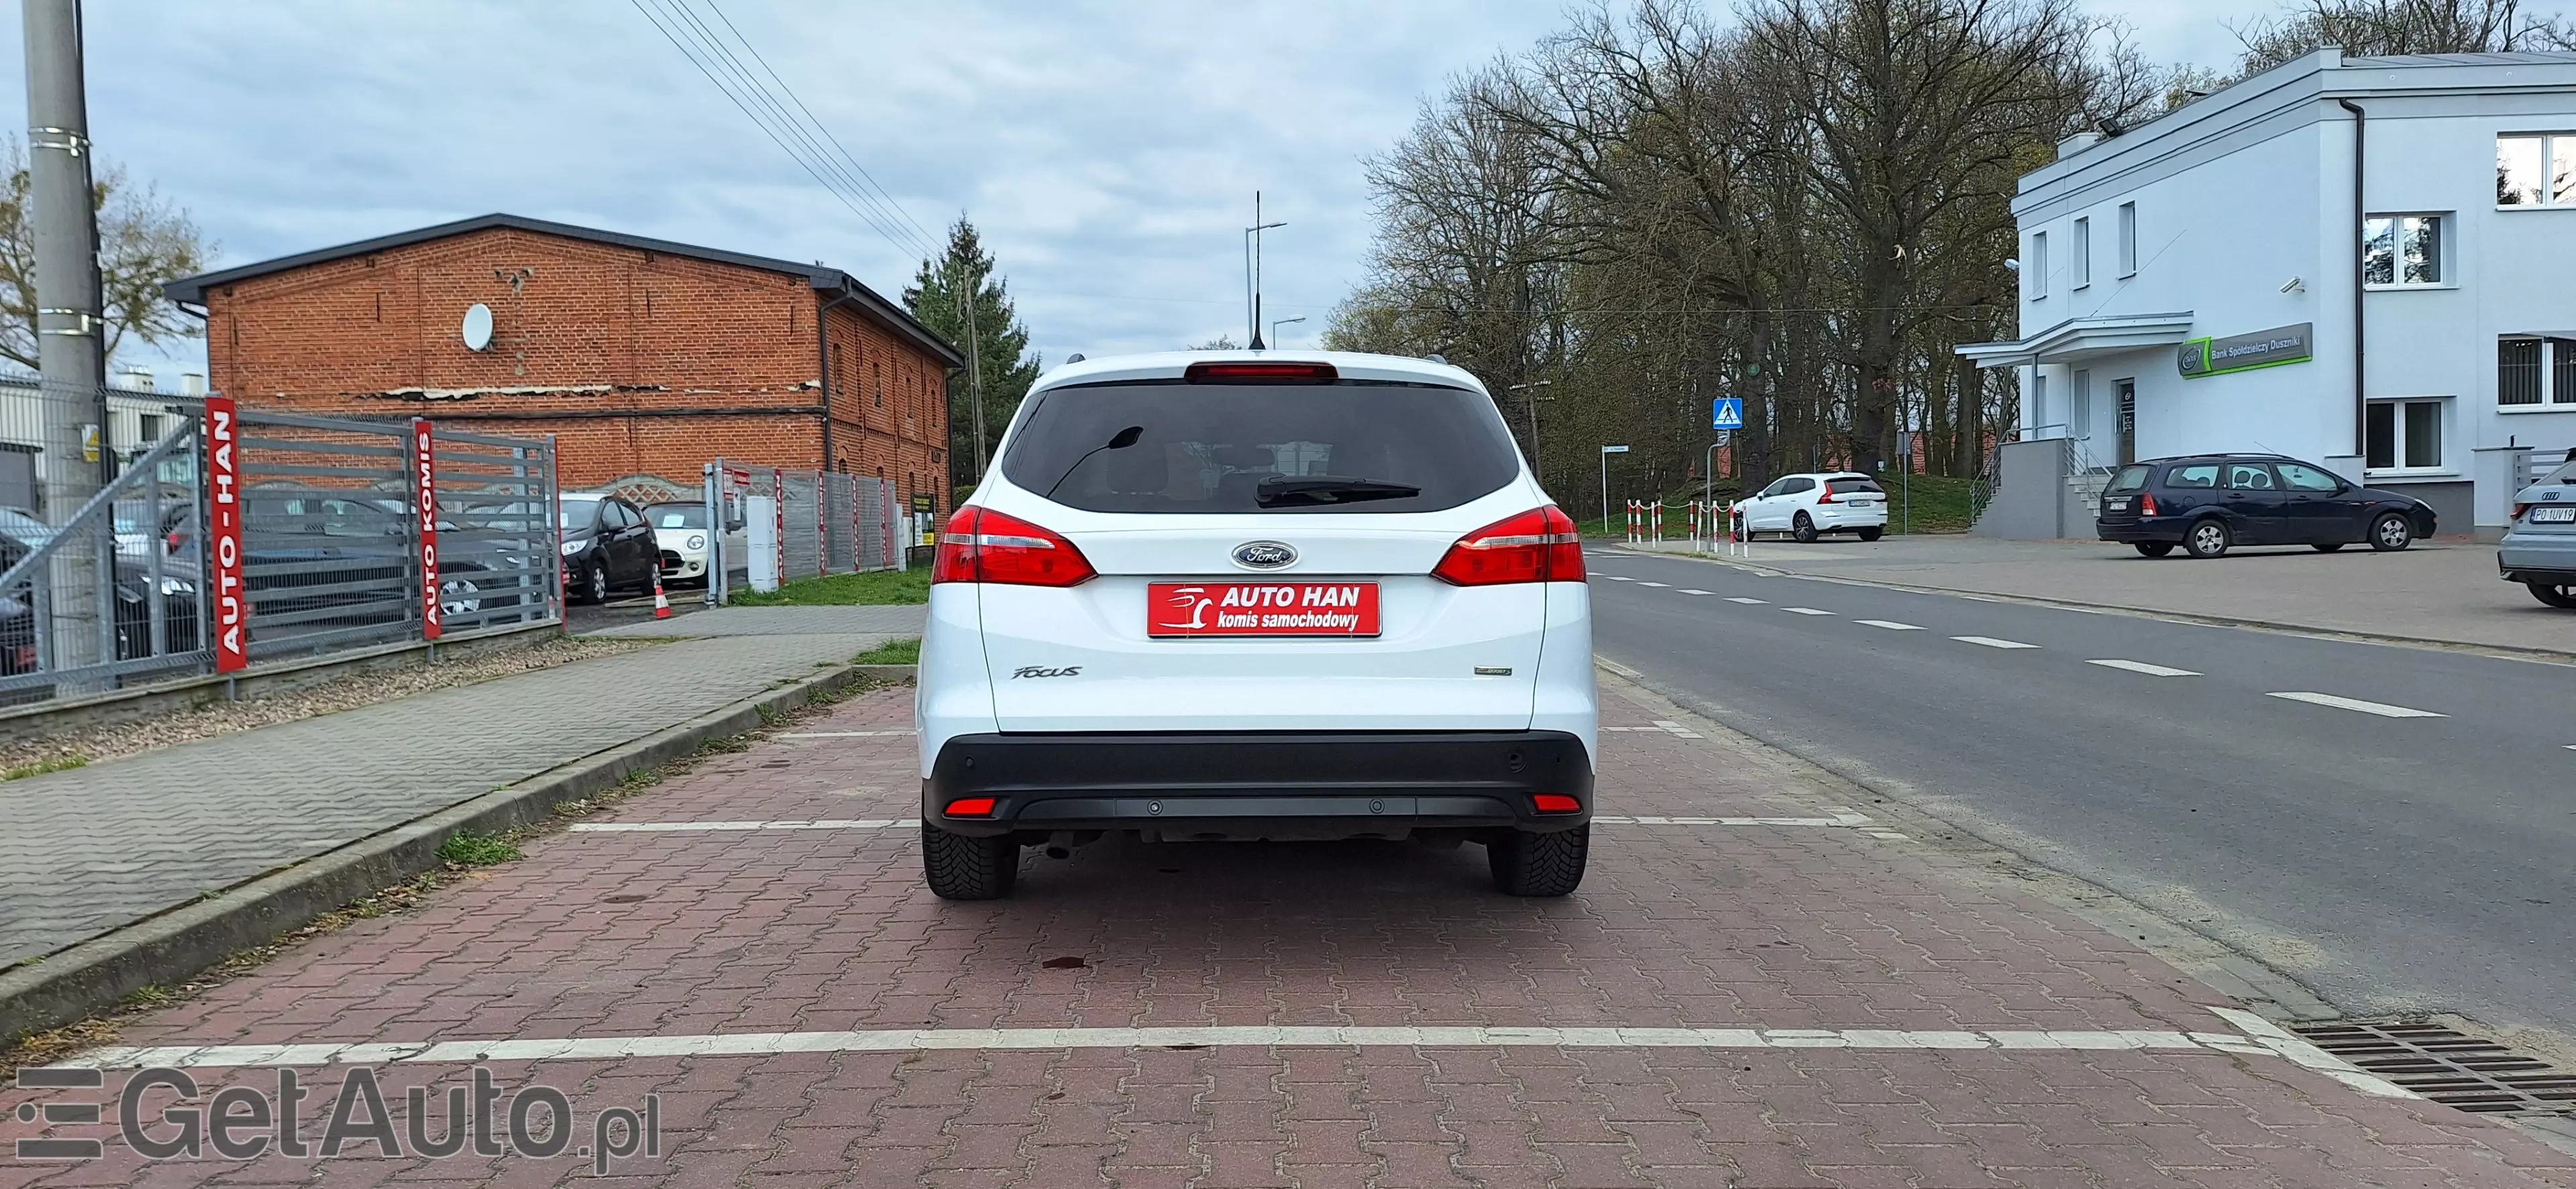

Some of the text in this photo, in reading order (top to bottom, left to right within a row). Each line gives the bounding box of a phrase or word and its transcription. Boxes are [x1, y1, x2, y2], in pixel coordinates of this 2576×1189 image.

[2212, 350, 2228, 359] Bank
[2229, 342, 2269, 358] Spółdzielczy
[2270, 336, 2300, 349] Duszniki
[2536, 509, 2573, 520] PO 1UV19
[419, 432, 437, 626] AUTO KOMIS
[1246, 547, 1283, 562] Ford
[1220, 587, 1360, 607] AUTO HAN
[1218, 610, 1359, 632] komis samochodowy
